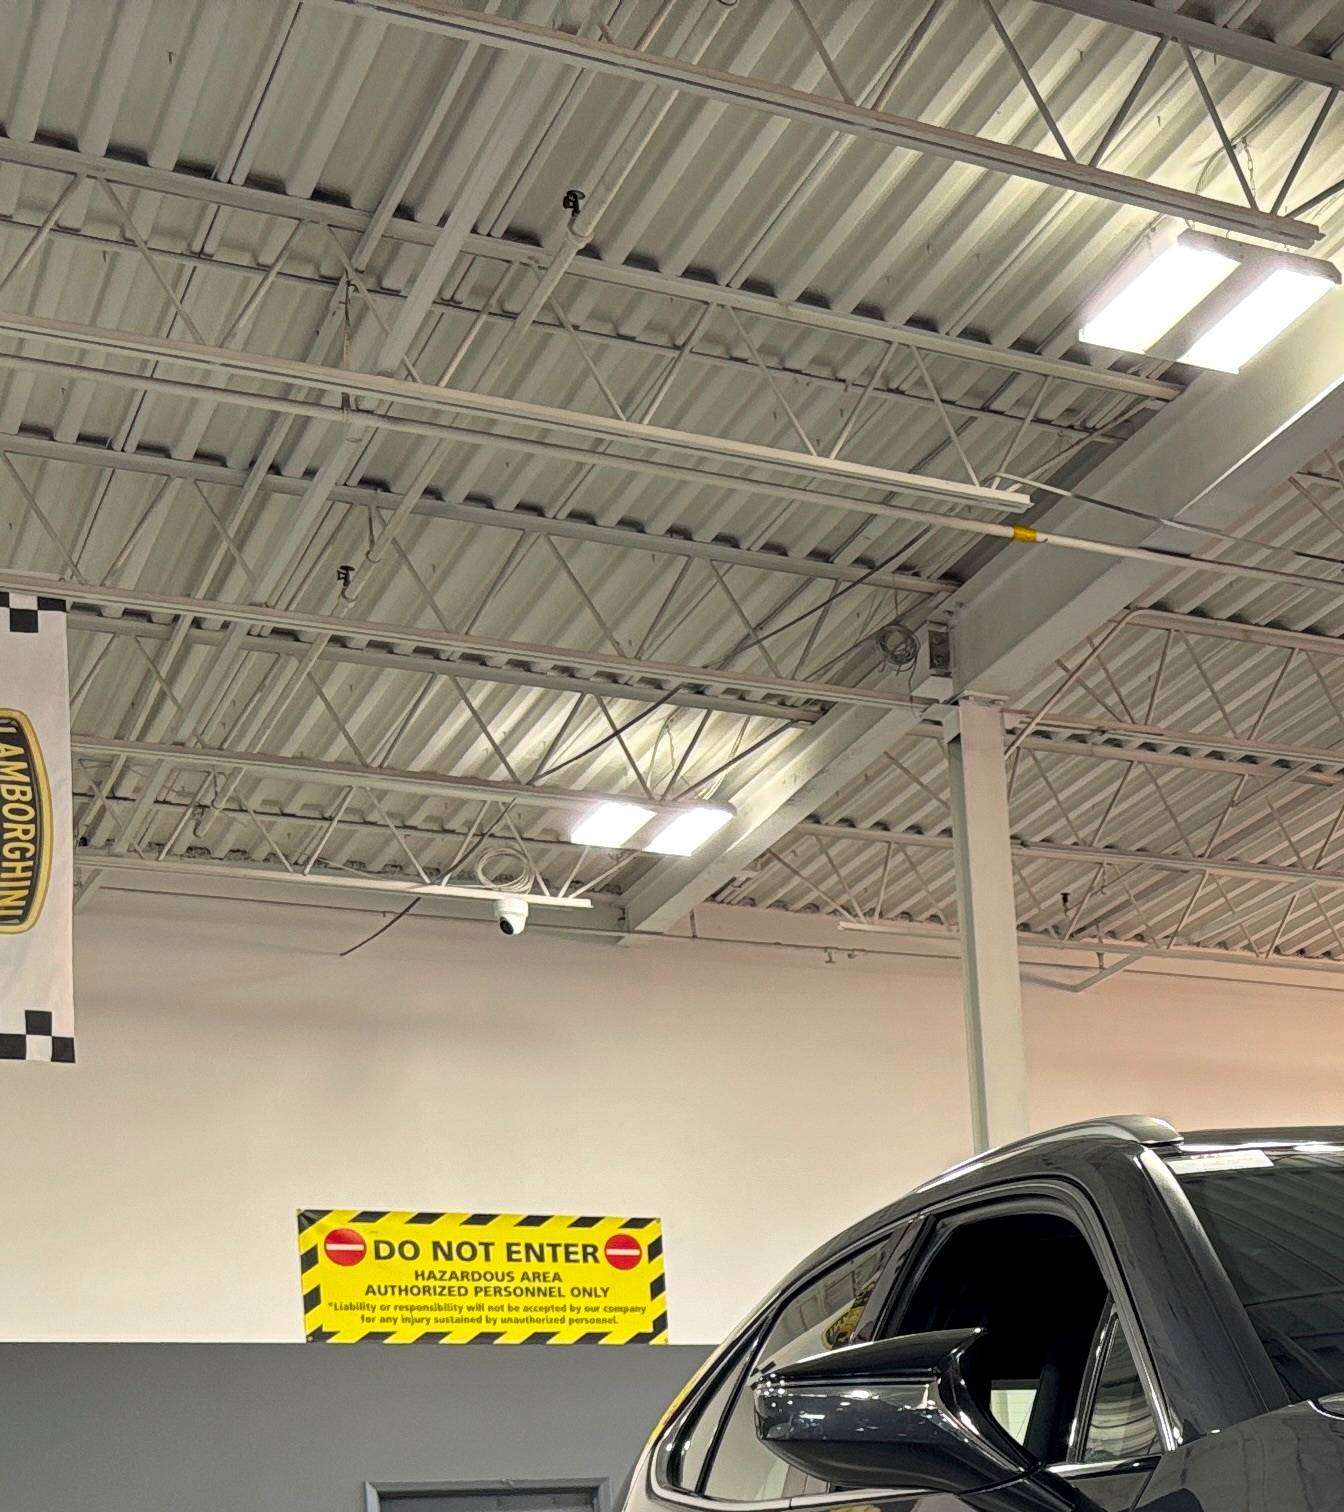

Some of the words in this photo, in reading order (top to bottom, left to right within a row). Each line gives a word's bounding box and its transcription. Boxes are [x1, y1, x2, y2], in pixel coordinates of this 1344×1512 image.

[374, 1239, 420, 1261] DO
[432, 1240, 495, 1262] NOT
[506, 1242, 600, 1264] ENTER
[414, 1270, 515, 1282] HAZARDOUS
[520, 1271, 563, 1283] AREA
[365, 1284, 468, 1297] AUTHORIZED
[474, 1285, 565, 1298] PERSONNEL
[570, 1286, 610, 1298] ONLY
[394, 1302, 463, 1314] responsibility
[467, 1303, 485, 1312] will
[488, 1304, 505, 1312] not
[508, 1304, 520, 1312] be
[523, 1304, 567, 1314] accepted
[570, 1304, 581, 1315] by
[604, 1305, 647, 1315] company
[361, 1314, 376, 1323] for
[380, 1316, 398, 1325] any
[401, 1314, 431, 1326] injury
[434, 1315, 482, 1324] sustained
[486, 1315, 497, 1326] by
[500, 1315, 565, 1325] unauthorized
